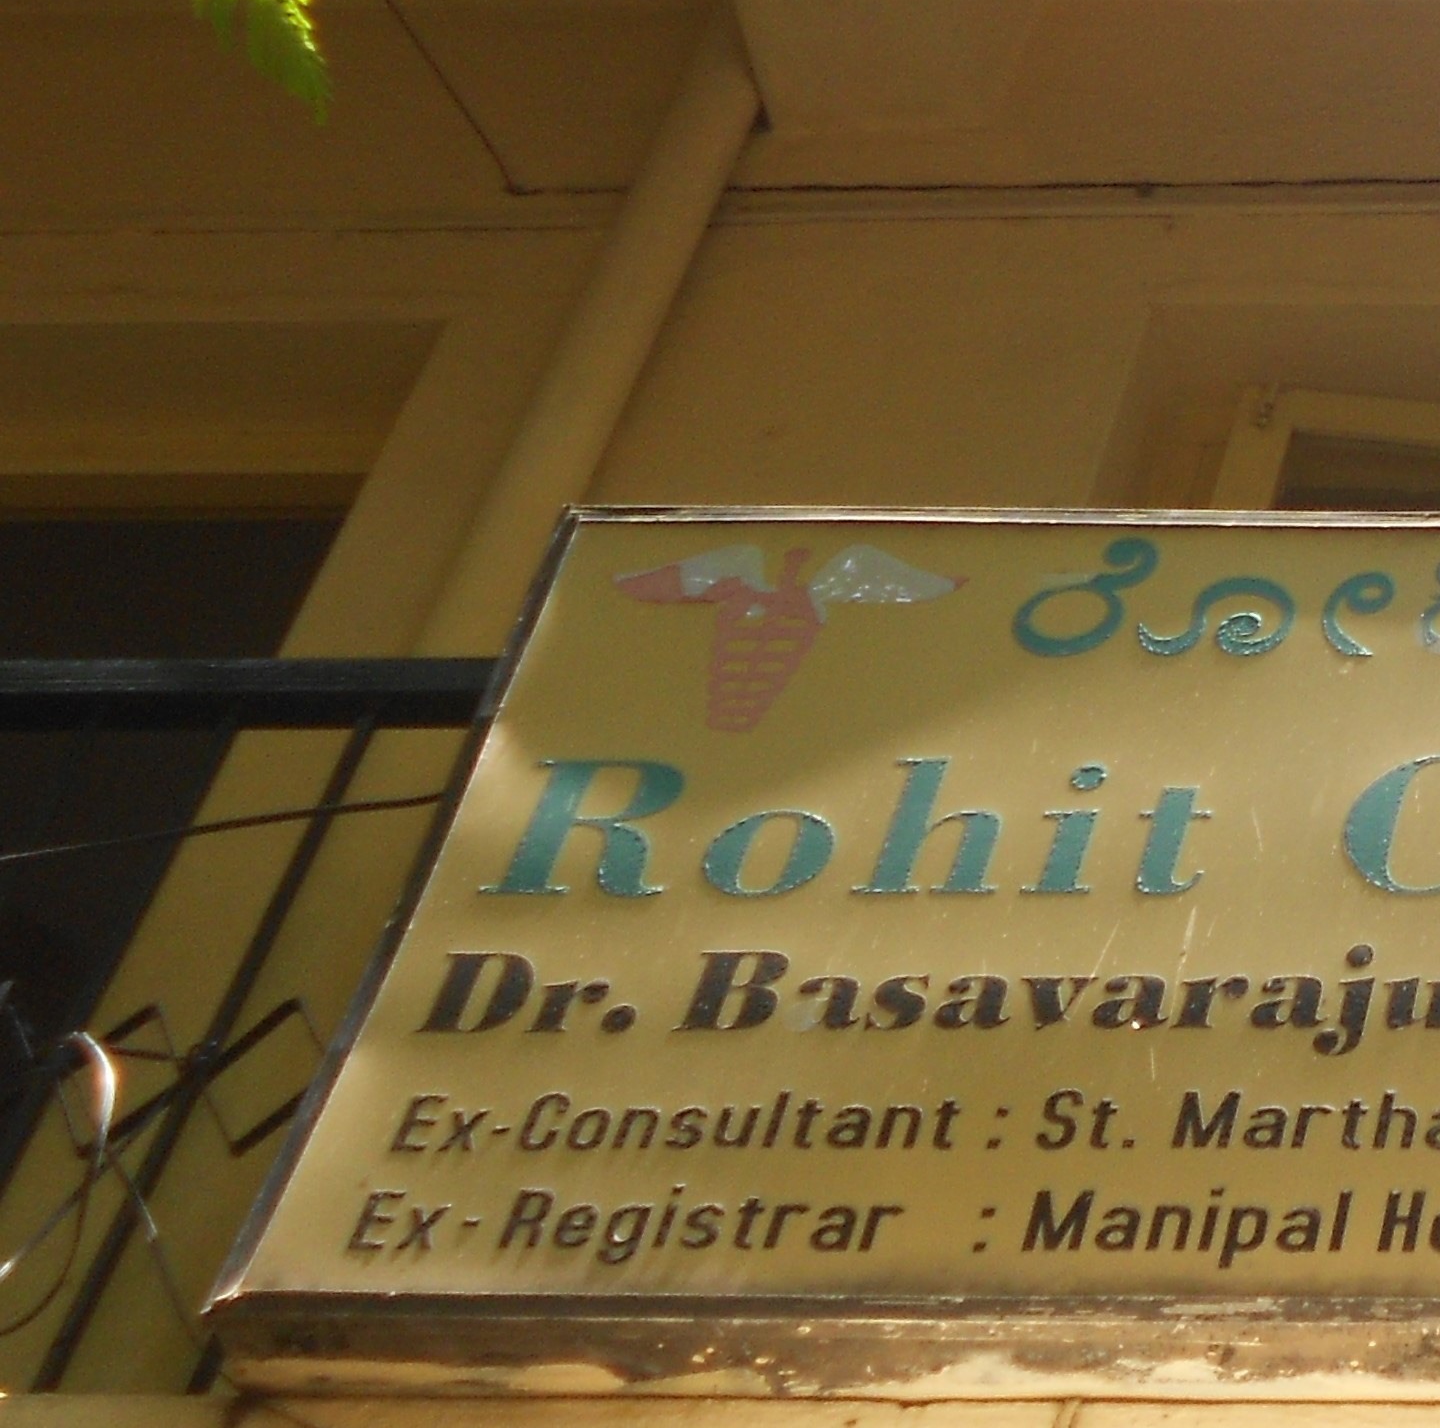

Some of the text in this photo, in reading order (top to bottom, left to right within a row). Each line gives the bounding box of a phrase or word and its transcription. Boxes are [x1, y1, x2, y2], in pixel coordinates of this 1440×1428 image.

[478, 757, 1212, 897] Rohit
[414, 950, 640, 1035] Dr.
[391, 1088, 962, 1156] Ex-Consultant
[1035, 1089, 1136, 1150] St.
[1021, 1187, 1353, 1269] Manipal
